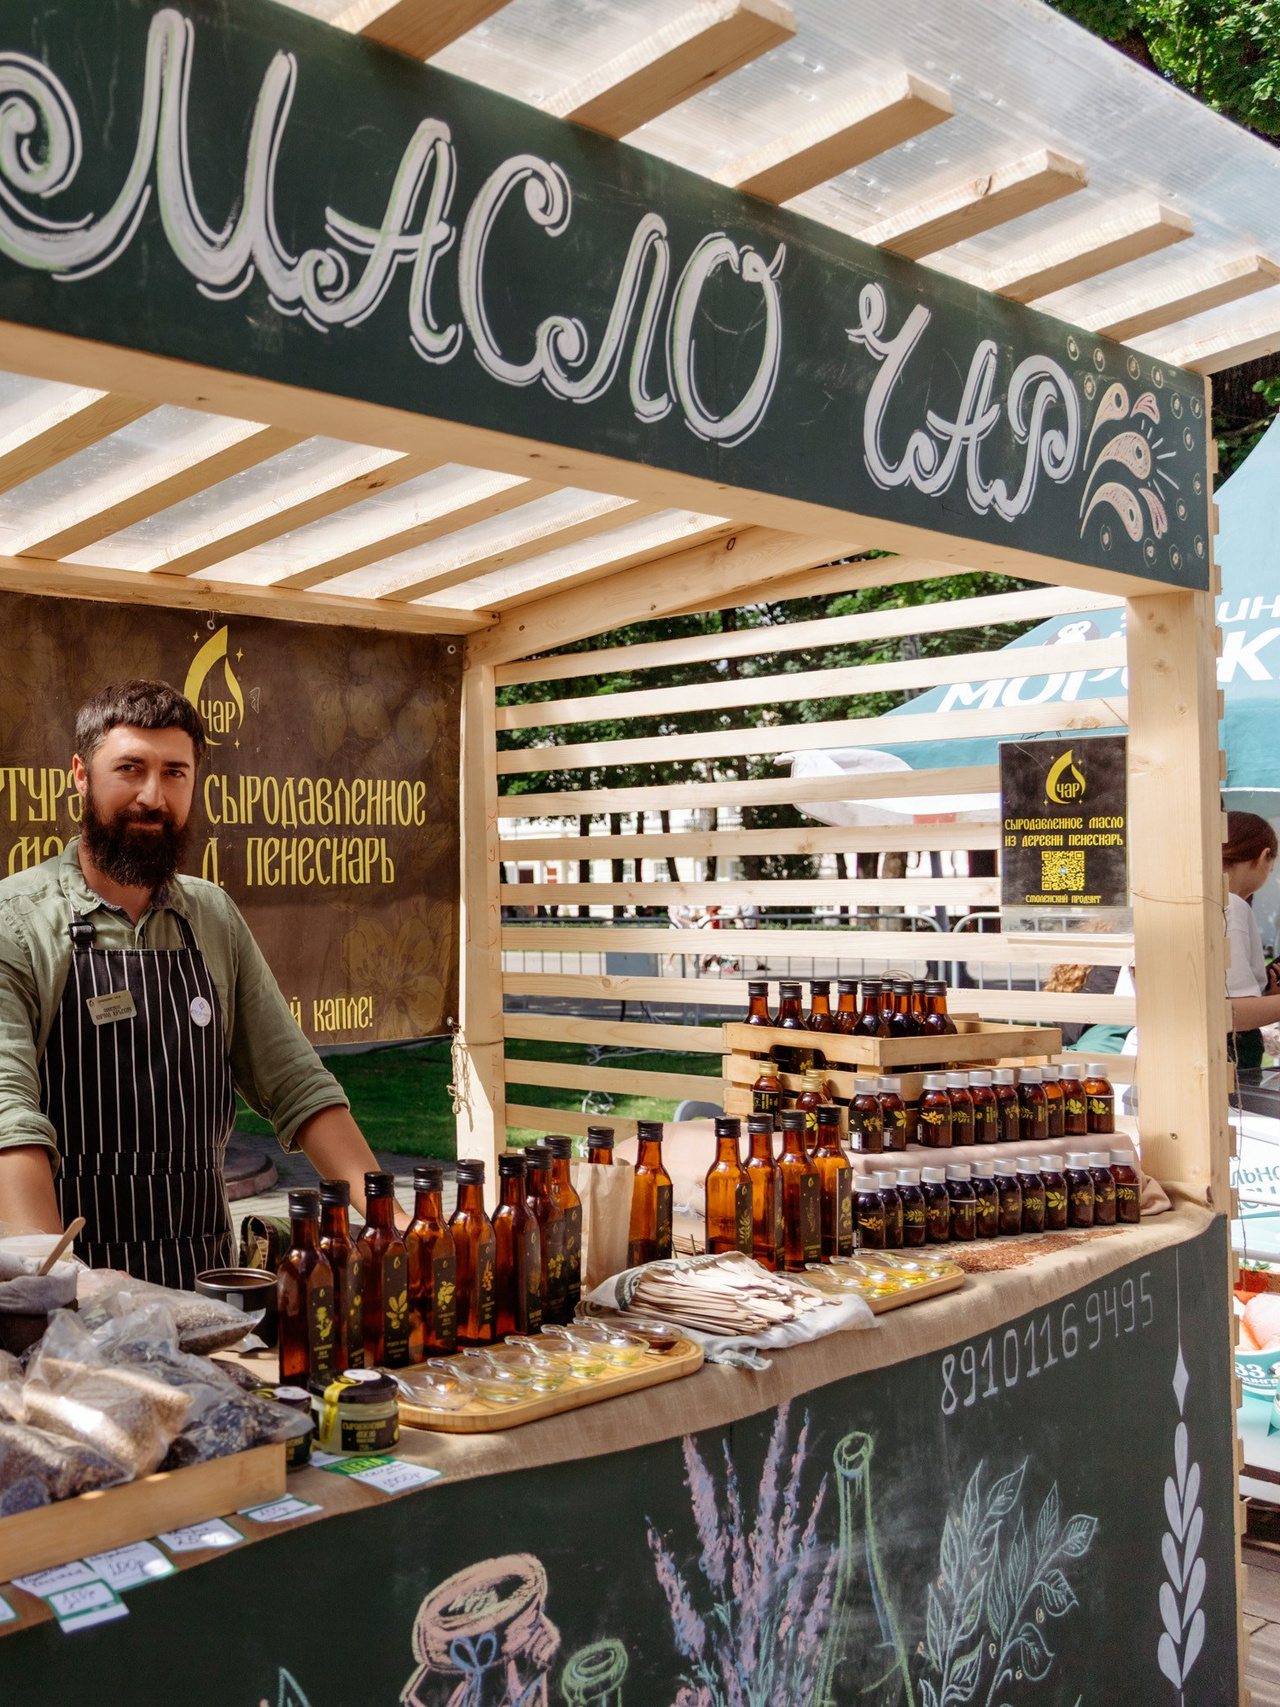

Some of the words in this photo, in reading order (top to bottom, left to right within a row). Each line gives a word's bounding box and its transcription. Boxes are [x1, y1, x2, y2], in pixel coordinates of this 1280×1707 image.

[845, 282, 1080, 522] ЧАР
[200, 699, 236, 733] ЧАР
[203, 773, 426, 829] СЫРОДАВЛЕННОЕ
[1056, 782, 1080, 798] ЧАР
[1005, 817, 1083, 831] СЫРОДАВЛЕННОЕ
[1089, 816, 1124, 829] МАСЛО
[1005, 835, 1016, 847] ИЗ
[1022, 835, 1063, 847] ДЕРЕВНИ
[1068, 833, 1124, 846] ПЕНЕСНАРЬ
[246, 836, 395, 886] ПЕНЕСНАРЬ
[1025, 894, 1068, 904] СМОЛЕНСКИЙ
[1071, 894, 1102, 904] ПРОДУКТ
[313, 995, 373, 1032] КАПЛЕ!
